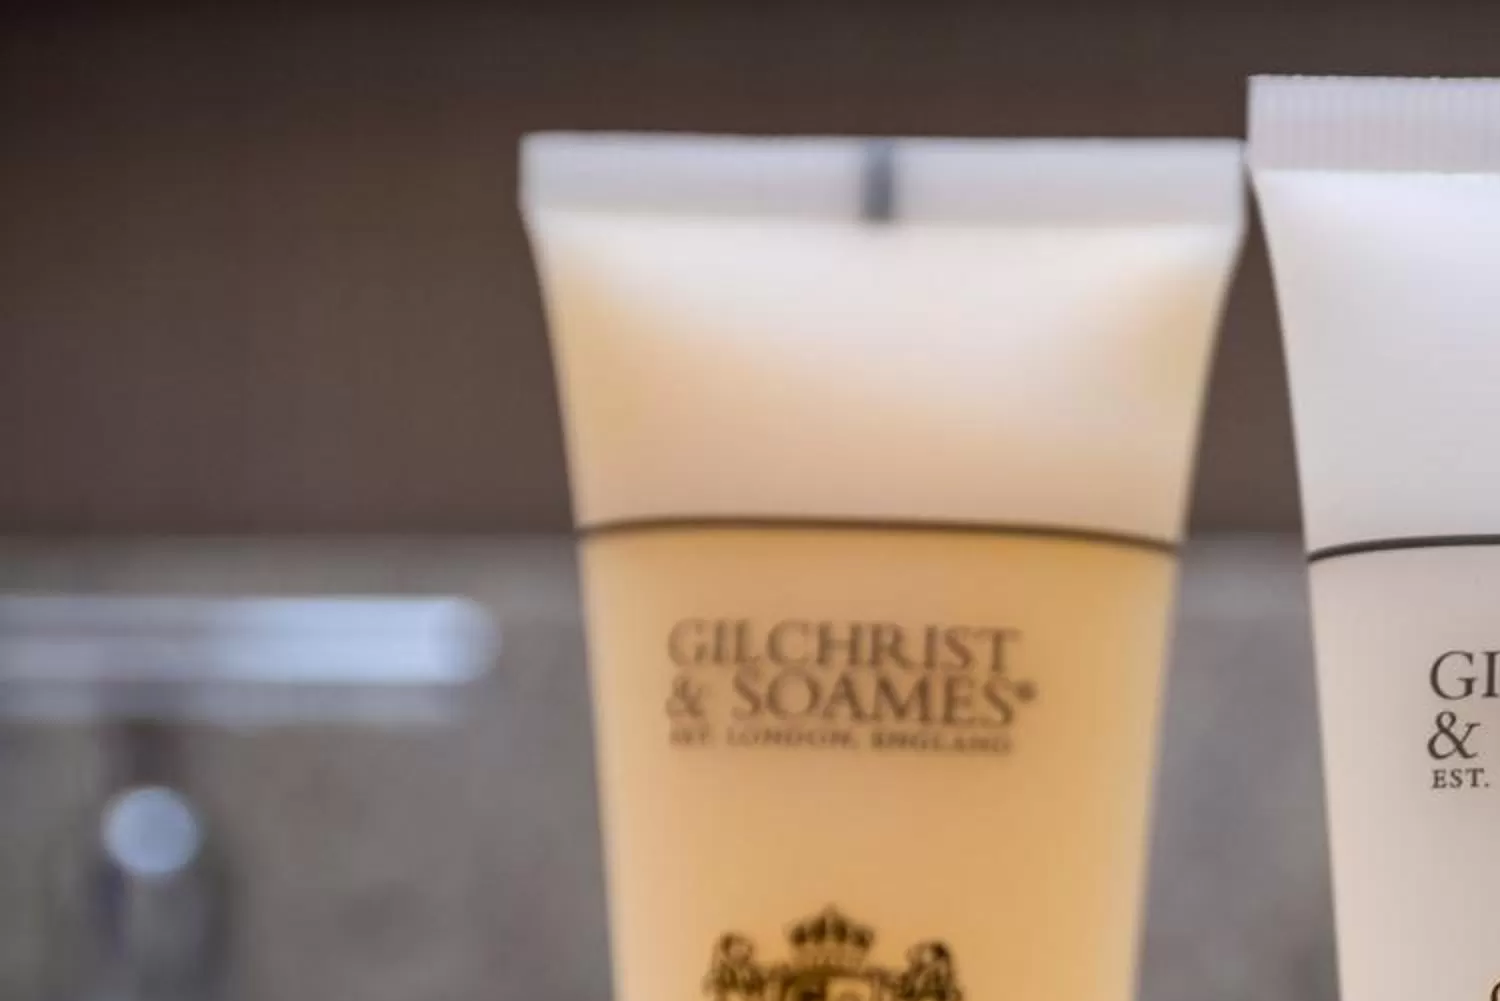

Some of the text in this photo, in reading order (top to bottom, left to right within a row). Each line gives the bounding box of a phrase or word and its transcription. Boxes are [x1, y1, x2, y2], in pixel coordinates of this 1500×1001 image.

[667, 618, 1022, 671] GILCHRIST
[665, 673, 703, 719] &
[1427, 711, 1481, 760] &
[1432, 768, 1489, 789] EST.
